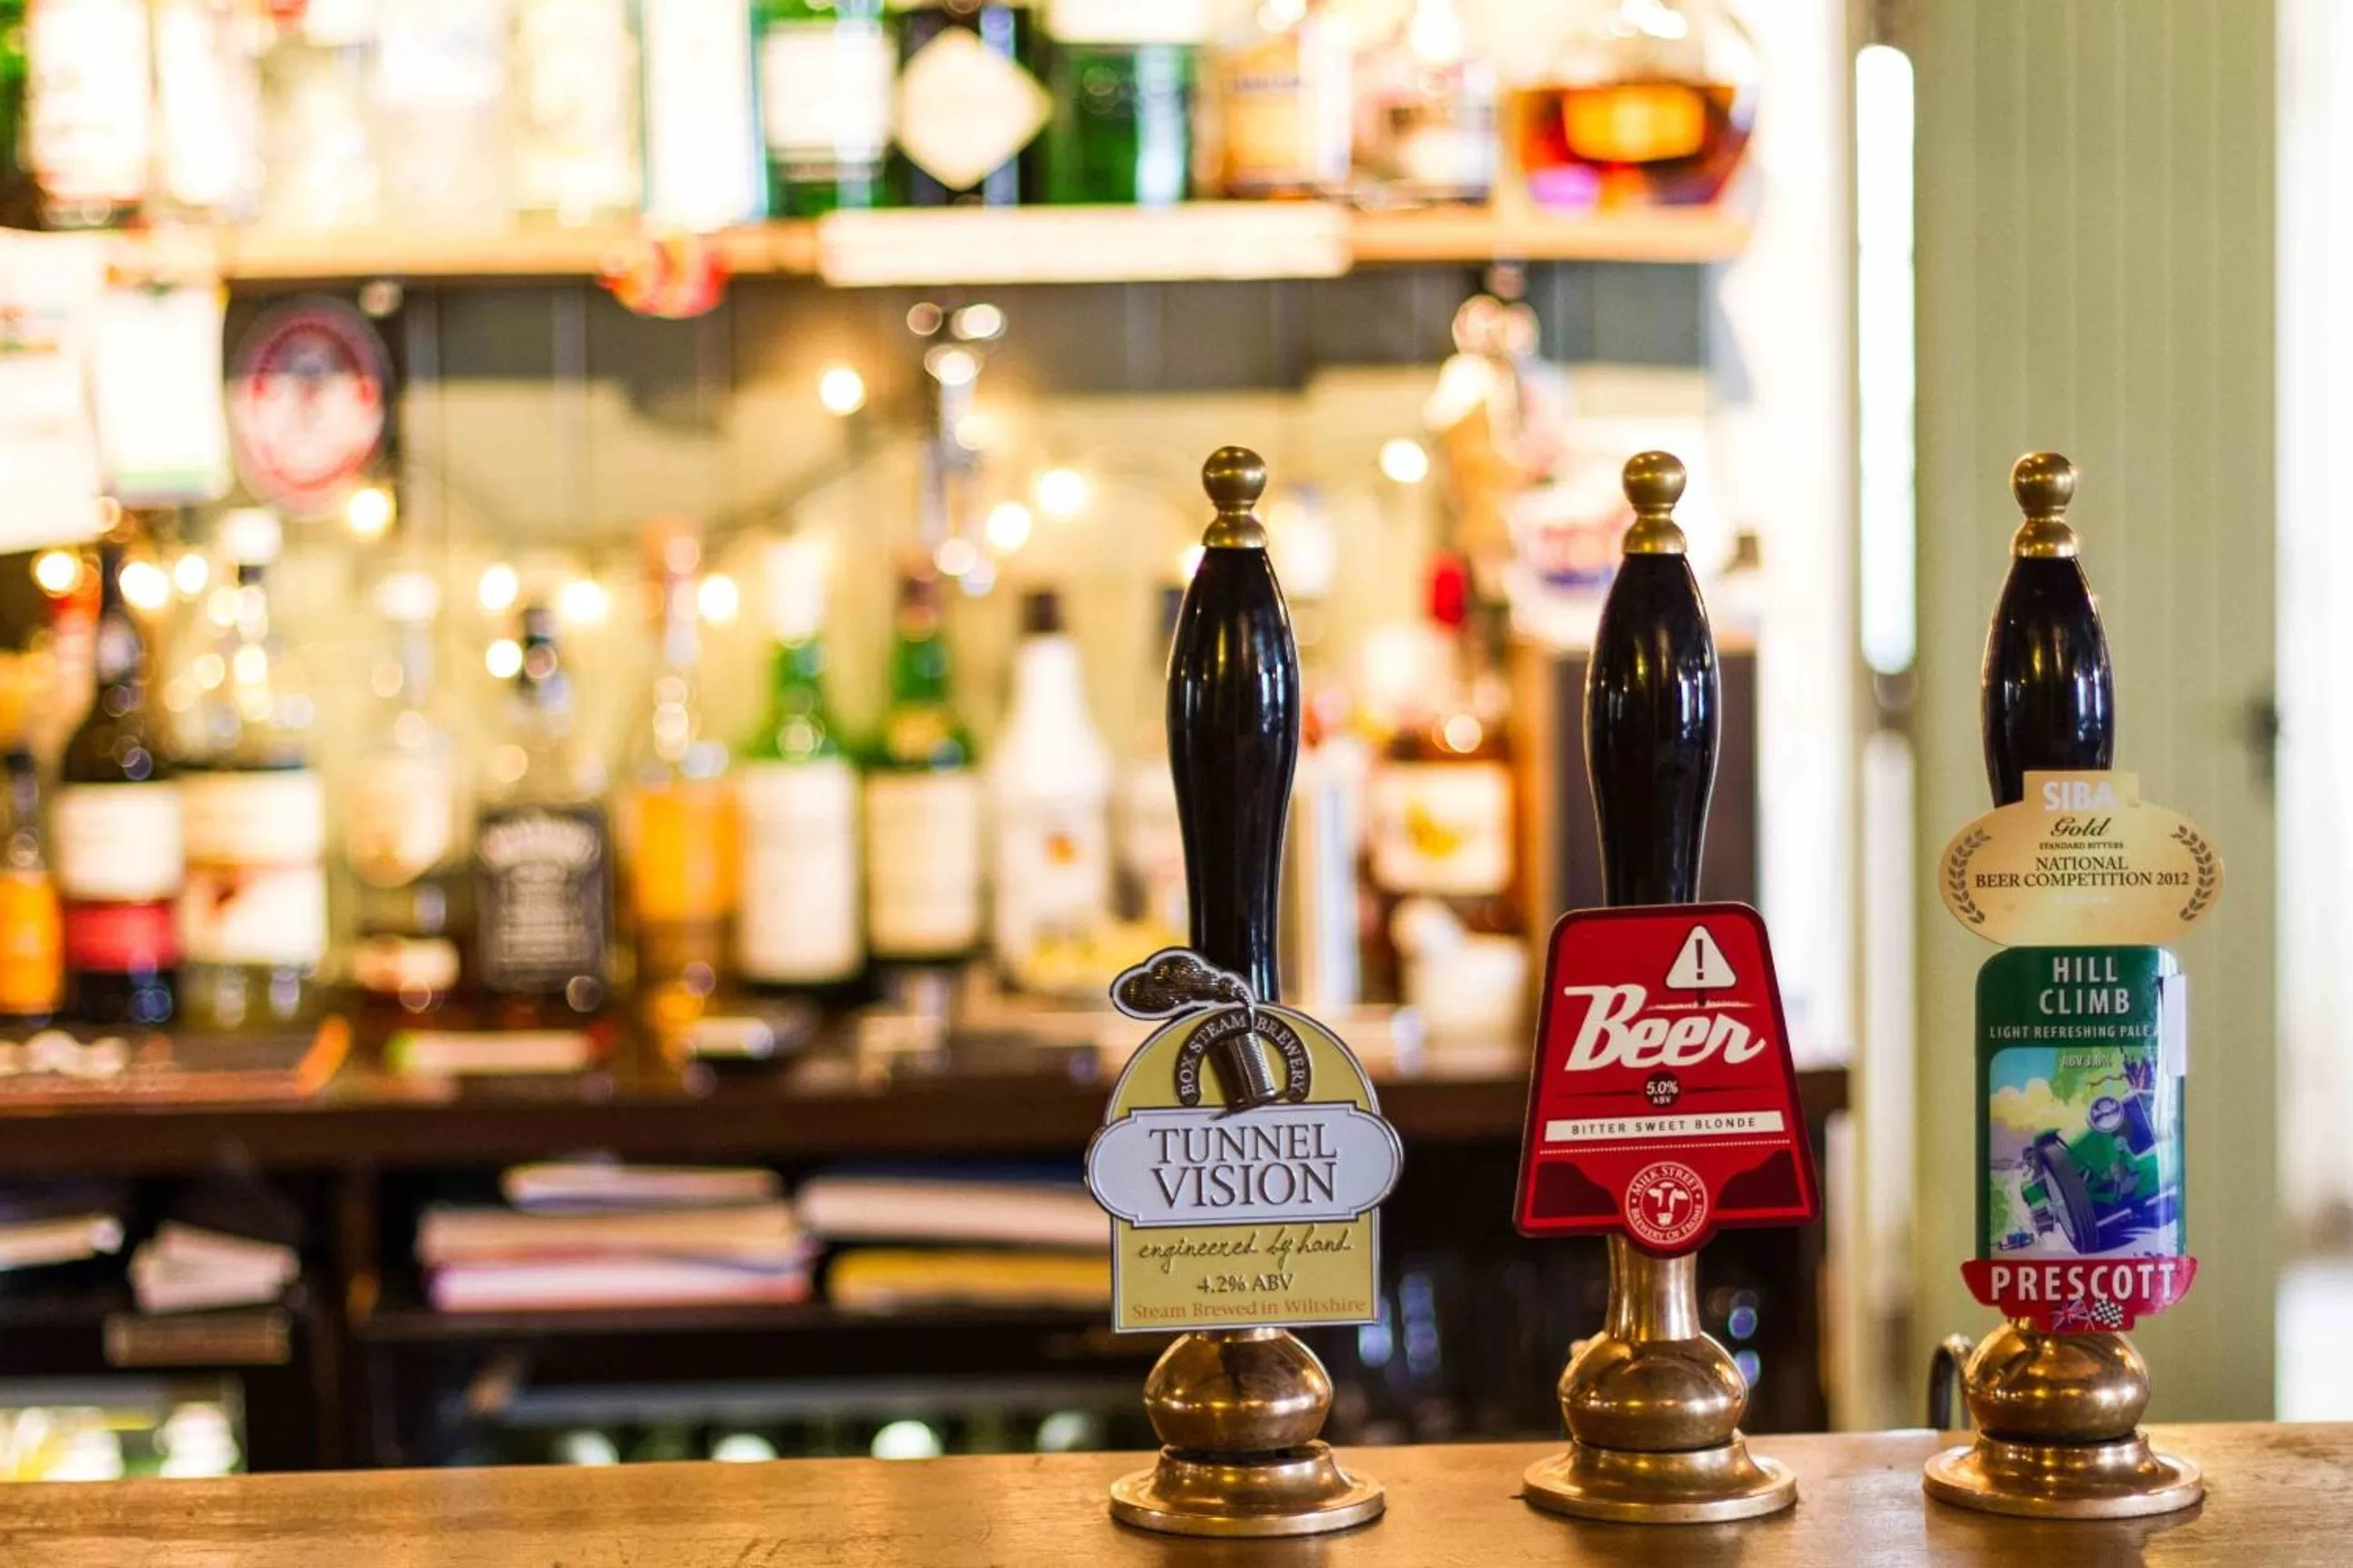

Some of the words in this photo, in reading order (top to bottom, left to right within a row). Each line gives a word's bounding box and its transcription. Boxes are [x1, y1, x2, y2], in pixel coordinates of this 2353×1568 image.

[2042, 781, 2118, 811] SIBA
[2050, 817, 2112, 836] Gold
[2038, 842, 2085, 851] STANDARD
[2035, 856, 2128, 871] NATIONAL
[1975, 873, 2020, 888] BEER
[2024, 872, 2152, 887] COMPETITION
[2157, 872, 2189, 886] 2012
[2052, 956, 2118, 983] HILL
[2038, 988, 2130, 1015] CLIMB
[1564, 983, 1767, 1072] Beer
[1989, 1024, 2029, 1039] LIGHT
[2034, 1024, 2116, 1039] REFRESHING
[2119, 1024, 2151, 1038] PALE
[1179, 1054, 1196, 1094] BOX
[1189, 1014, 1248, 1054] STEAM
[1255, 1015, 1306, 1094] BREWERY
[1646, 1081, 1678, 1096] 5.0%
[1652, 1096, 1672, 1104] ABV
[1571, 1124, 1626, 1135] BITTER
[1635, 1120, 1686, 1133] SWEET
[1694, 1117, 1756, 1130] BLONDE
[1149, 1124, 1337, 1164] TUNNEL
[1151, 1163, 1337, 1209] VISION
[1631, 1169, 1659, 1196] MILK
[1661, 1166, 1700, 1192] STREET
[1138, 1229, 1259, 1273] engineered
[1267, 1226, 1296, 1271] by
[1197, 1274, 1246, 1293] 4.2%
[1252, 1273, 1294, 1292] ABV
[1990, 1263, 2176, 1302] PRESCOTT
[1131, 1302, 1187, 1319] Steam
[1193, 1300, 1257, 1317] Brewed
[1261, 1300, 1279, 1315] in
[1284, 1296, 1367, 1314] Wiltshire
